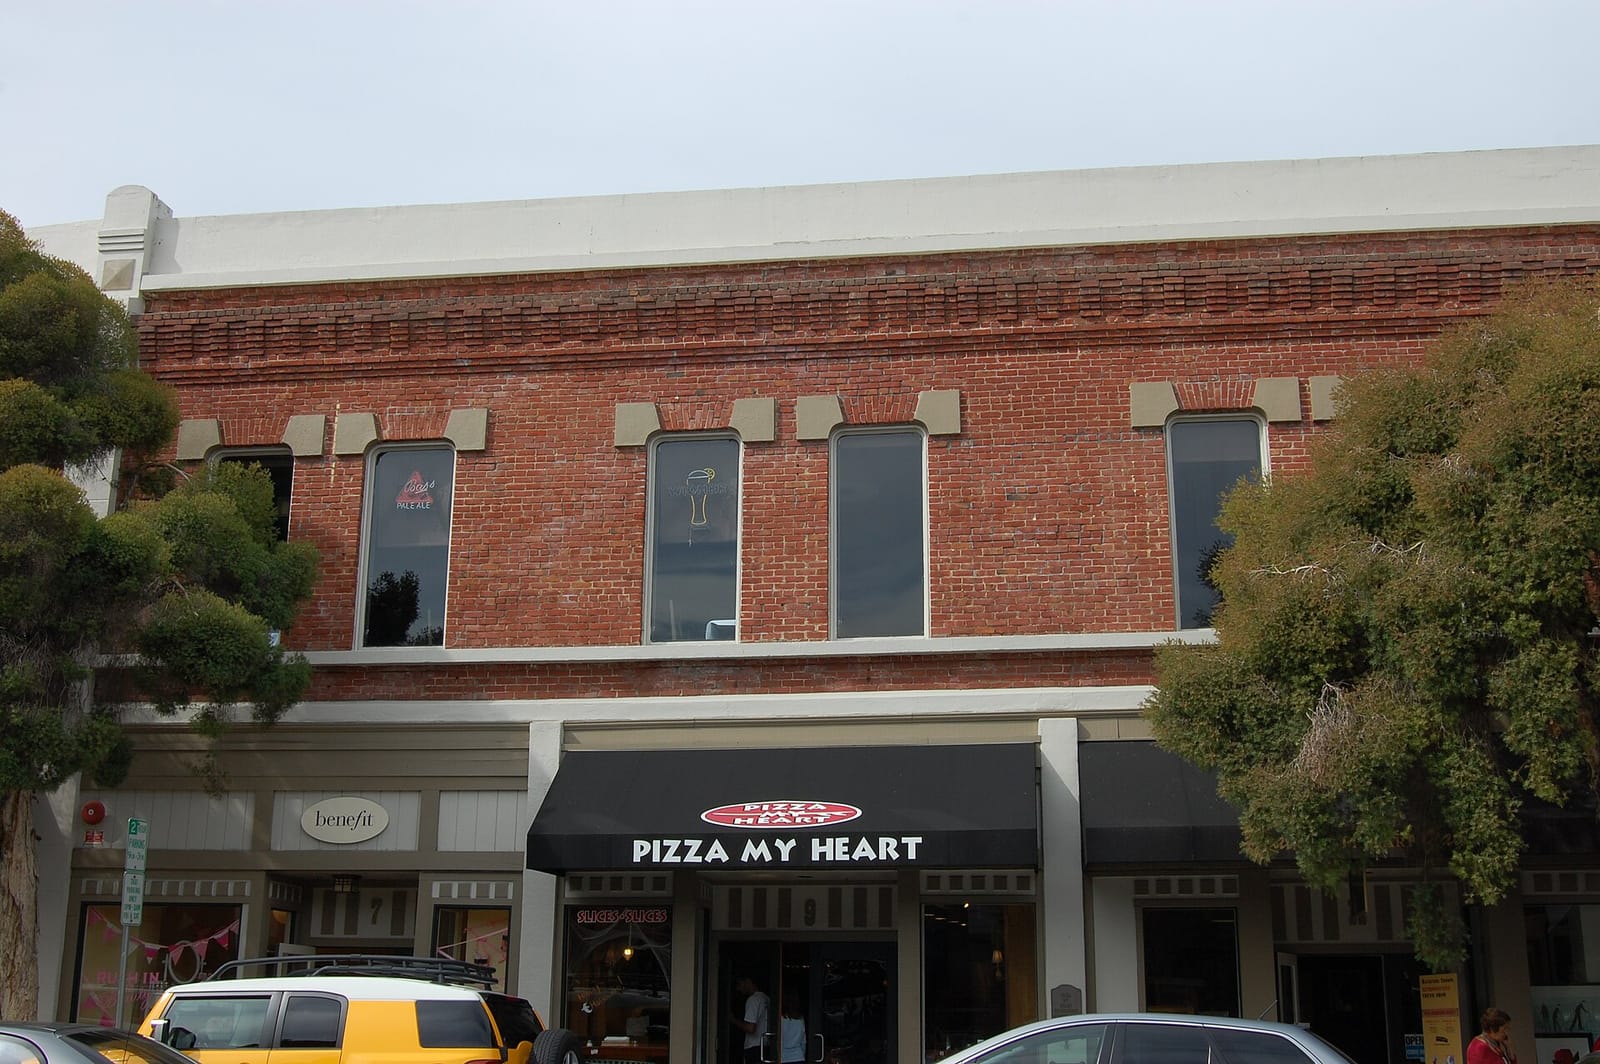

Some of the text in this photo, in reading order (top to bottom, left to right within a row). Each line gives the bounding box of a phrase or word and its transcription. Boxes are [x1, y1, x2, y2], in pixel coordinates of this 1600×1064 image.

[397, 502, 415, 510] PALE
[744, 803, 826, 811] PIZZA
[760, 810, 806, 818] MY
[130, 821, 137, 833] 2
[315, 810, 374, 831] benefit
[733, 816, 830, 825] HEART
[633, 837, 922, 863] PIZZA MY HEART
[370, 897, 383, 925] 7
[577, 909, 667, 923] SLICES SLICES
[804, 898, 817, 927] 9
[96, 971, 160, 985] RUH IN
